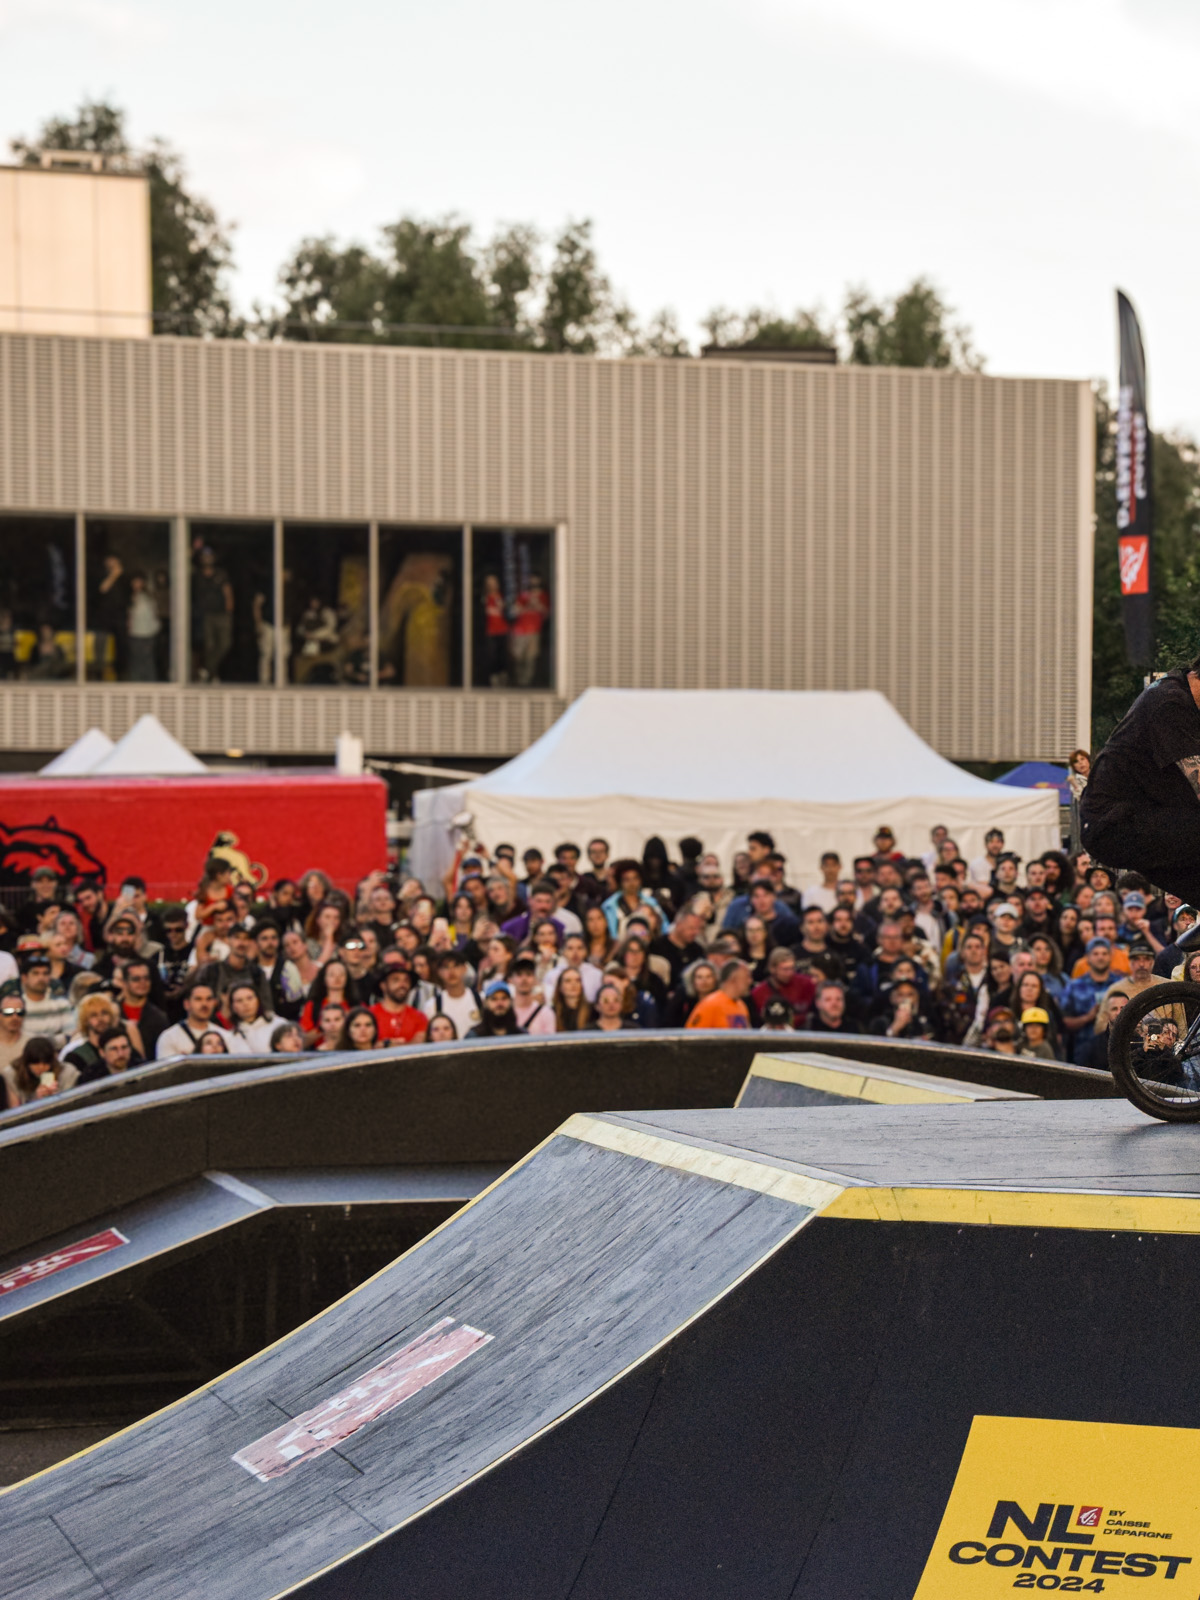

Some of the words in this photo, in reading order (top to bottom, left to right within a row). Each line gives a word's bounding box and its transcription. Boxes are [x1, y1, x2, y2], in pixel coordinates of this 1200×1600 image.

[1108, 1509, 1126, 1517] BY
[986, 1500, 1095, 1545] NL
[1106, 1519, 1151, 1529] CAISSE
[1103, 1528, 1173, 1540] D'ÉPARGNE
[948, 1541, 1193, 1580] CONTEST
[1012, 1572, 1105, 1594] 2024
